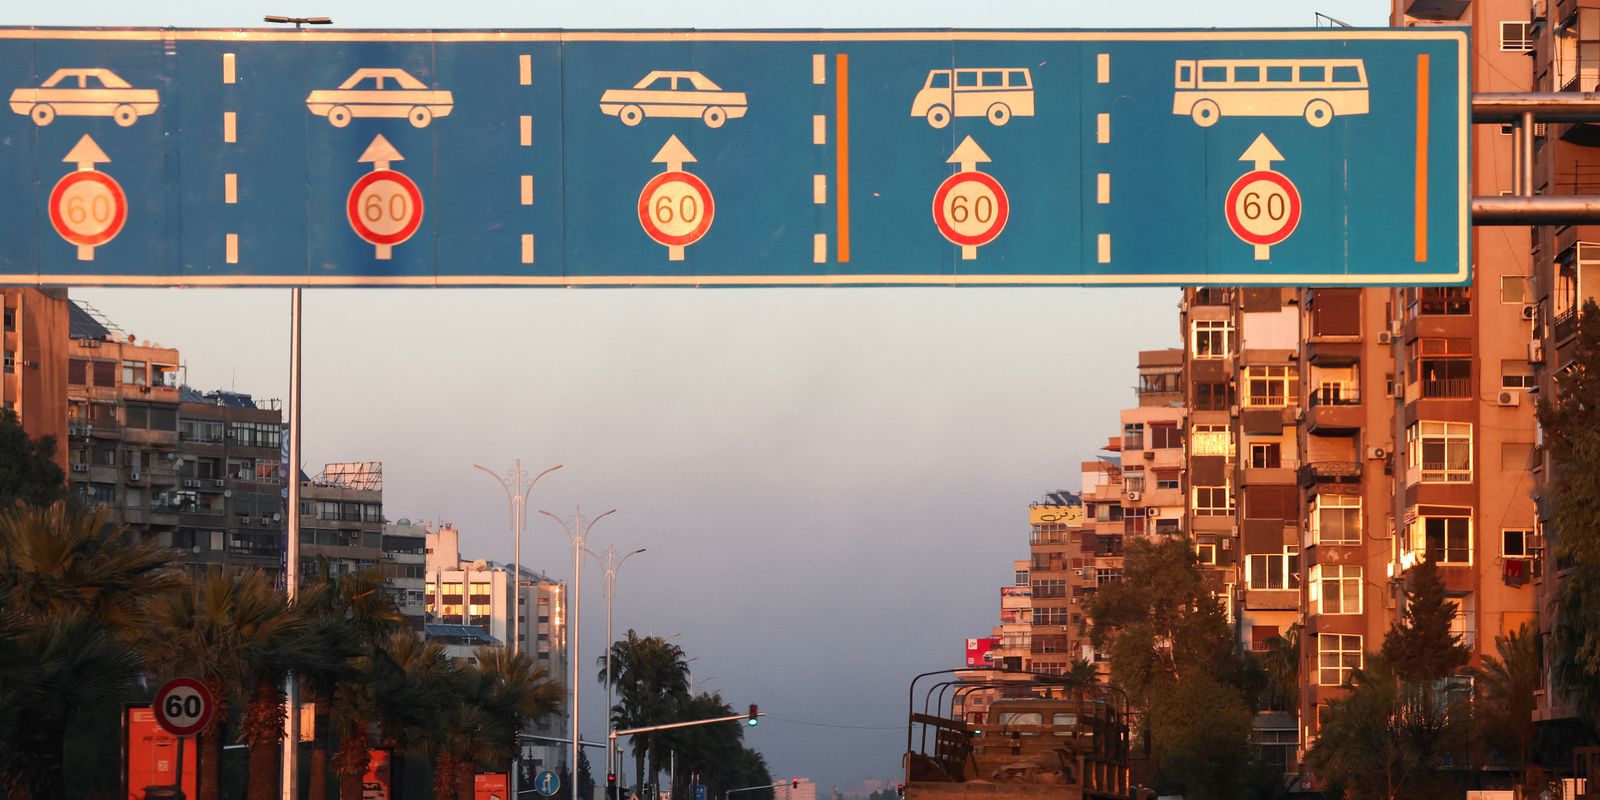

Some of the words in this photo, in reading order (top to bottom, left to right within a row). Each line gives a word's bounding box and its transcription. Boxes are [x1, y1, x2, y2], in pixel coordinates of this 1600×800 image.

[66, 194, 110, 225] 60
[364, 193, 407, 222] 60
[655, 195, 697, 223] 60
[950, 195, 993, 224] 60
[1243, 192, 1285, 220] 60
[165, 694, 201, 718] 60
